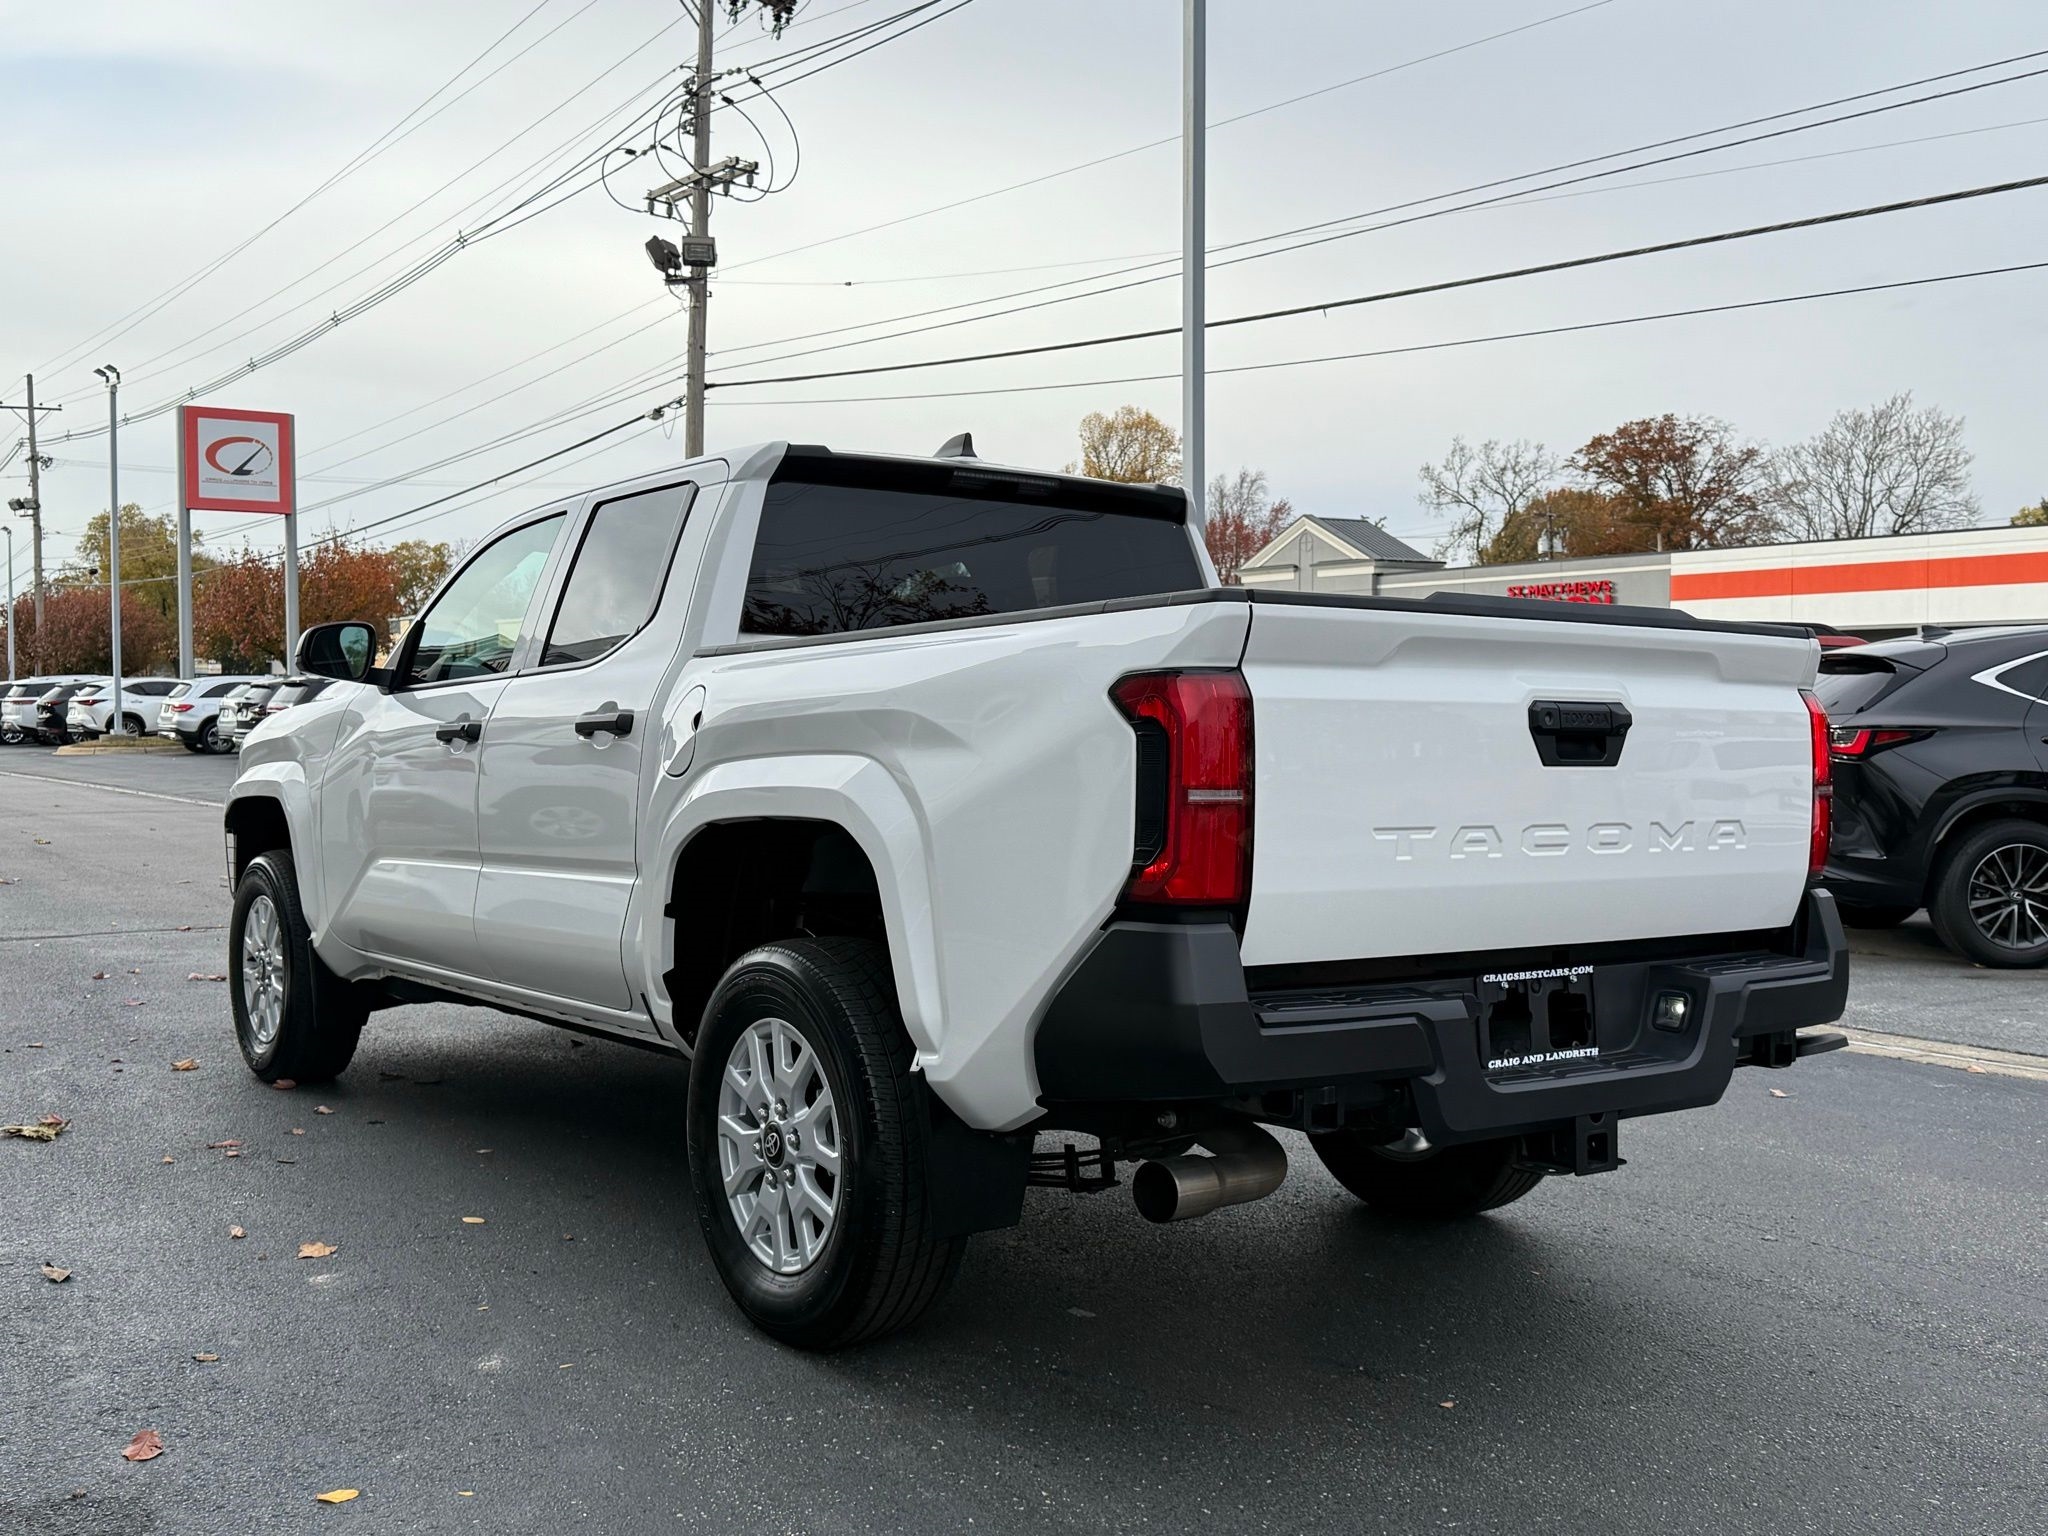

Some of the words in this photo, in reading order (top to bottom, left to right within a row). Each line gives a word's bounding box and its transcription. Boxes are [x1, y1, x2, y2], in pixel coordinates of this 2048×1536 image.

[1527, 580, 1612, 597] MATTHEWS
[1563, 712, 1609, 726] TOYOTA
[1372, 819, 1747, 861] TACOMA
[1483, 965, 1594, 983] CRAIGSBESTCARS.COM
[1488, 1058, 1520, 1069] CRAIG
[1522, 1054, 1544, 1065] AND
[1546, 1047, 1599, 1062] LANDRETH
